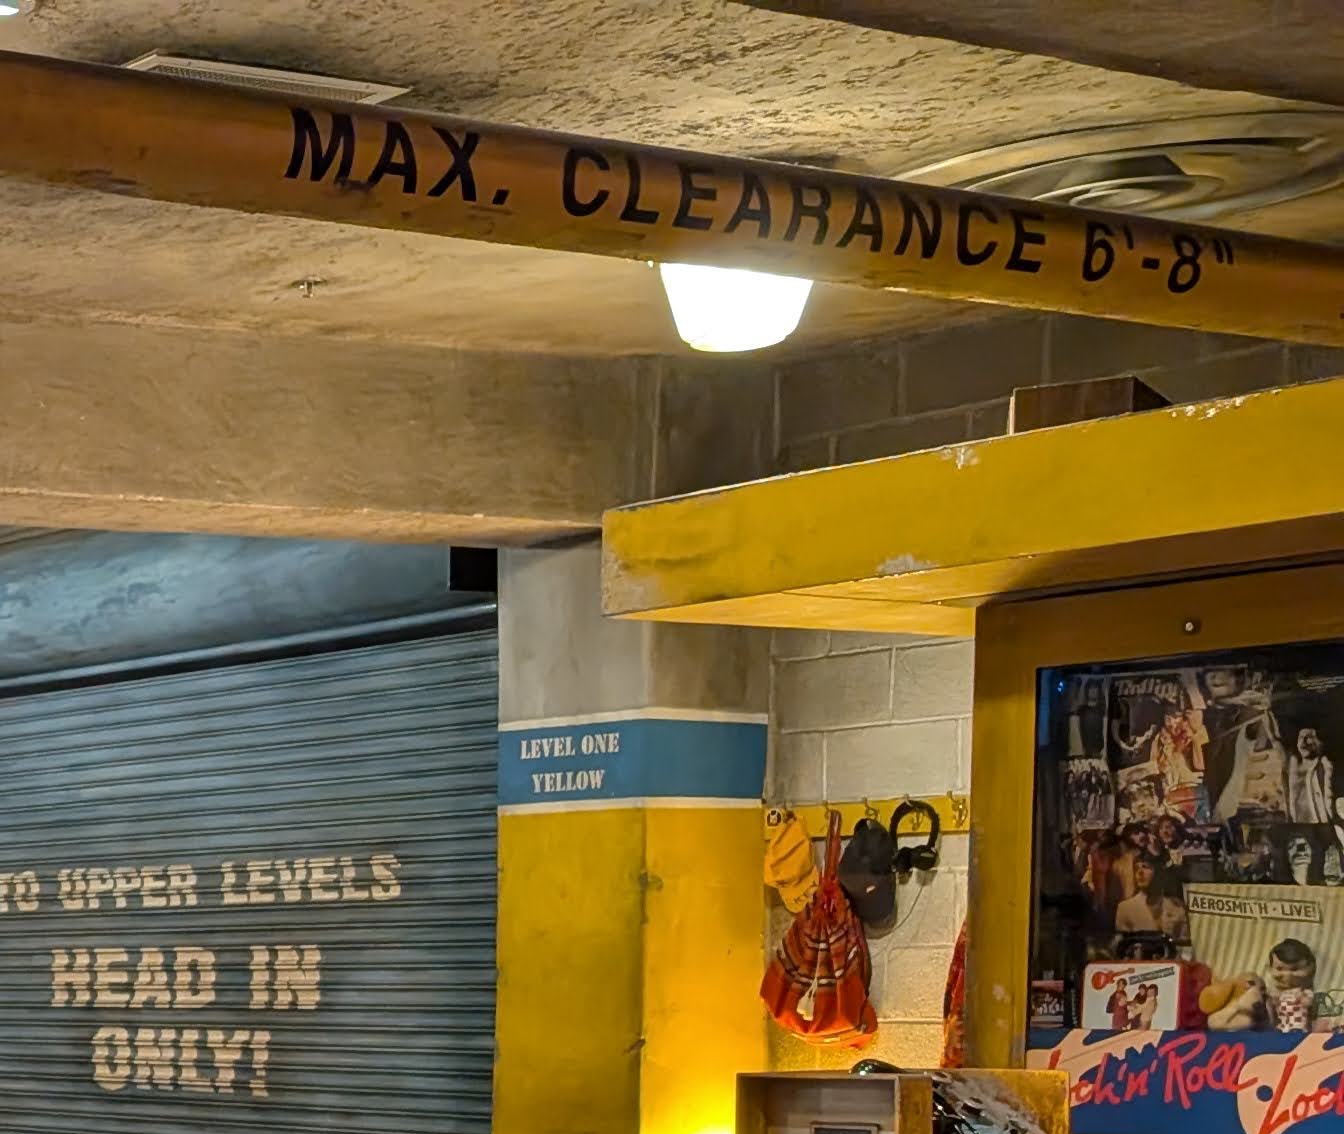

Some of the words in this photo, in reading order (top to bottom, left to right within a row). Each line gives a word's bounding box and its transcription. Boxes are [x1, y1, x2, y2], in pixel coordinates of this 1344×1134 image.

[284, 107, 507, 207] MAX.
[562, 145, 1047, 273] CLEARANCE
[520, 736, 575, 760] LEVEL
[581, 732, 620, 755] ONE
[532, 769, 605, 793] YELLOW
[56, 864, 197, 912] UPPER
[220, 854, 403, 904] LEVELS
[1191, 896, 1268, 915] AEROSMITH
[1281, 903, 1318, 918] LIVE!
[50, 947, 217, 1009] HEAD
[249, 944, 322, 1010] IN
[92, 1026, 272, 1098] ONLY!
